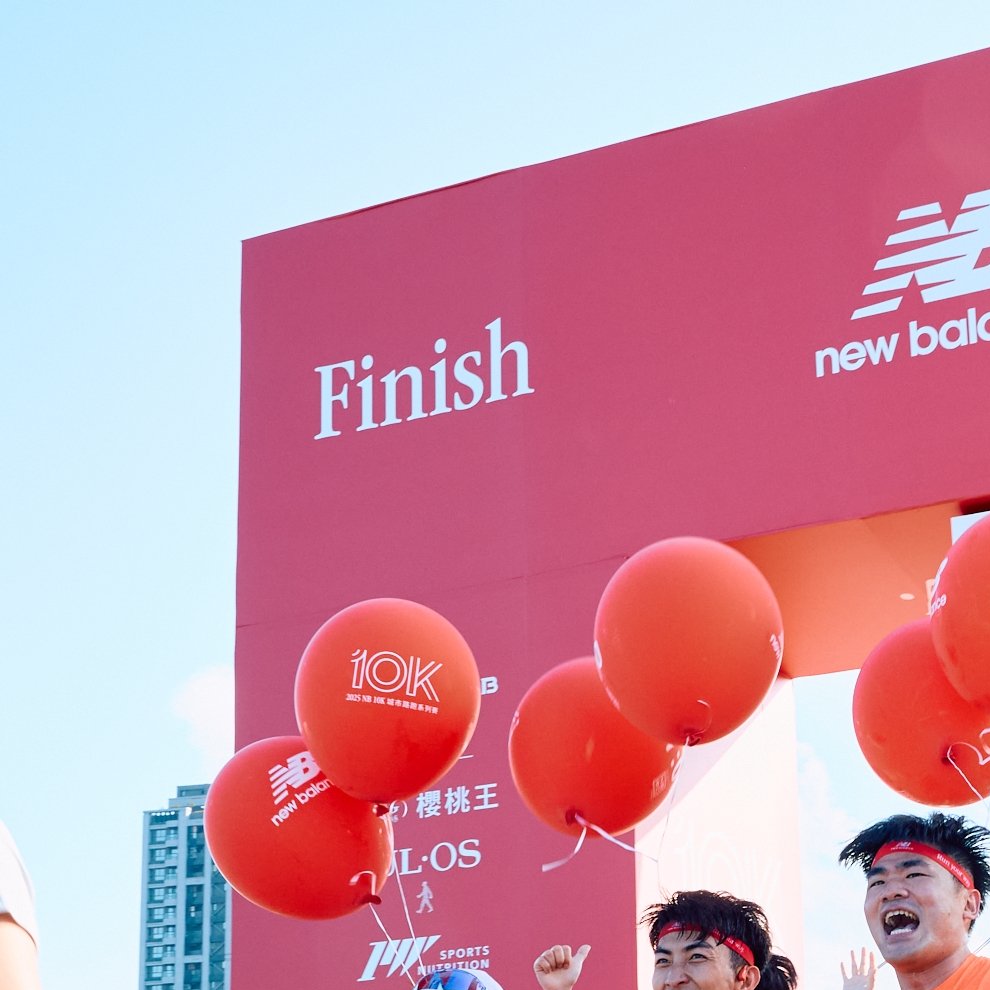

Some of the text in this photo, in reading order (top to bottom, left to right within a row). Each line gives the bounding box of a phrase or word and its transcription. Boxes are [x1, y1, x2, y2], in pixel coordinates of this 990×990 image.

[815, 332, 900, 378] new
[313, 316, 535, 440] Finish
[350, 649, 443, 703] 10K
[270, 802, 298, 827] new
[416, 783, 499, 819] 櫻桃王
[417, 959, 490, 975] NUTRITION
[439, 945, 490, 960] SPORTS
